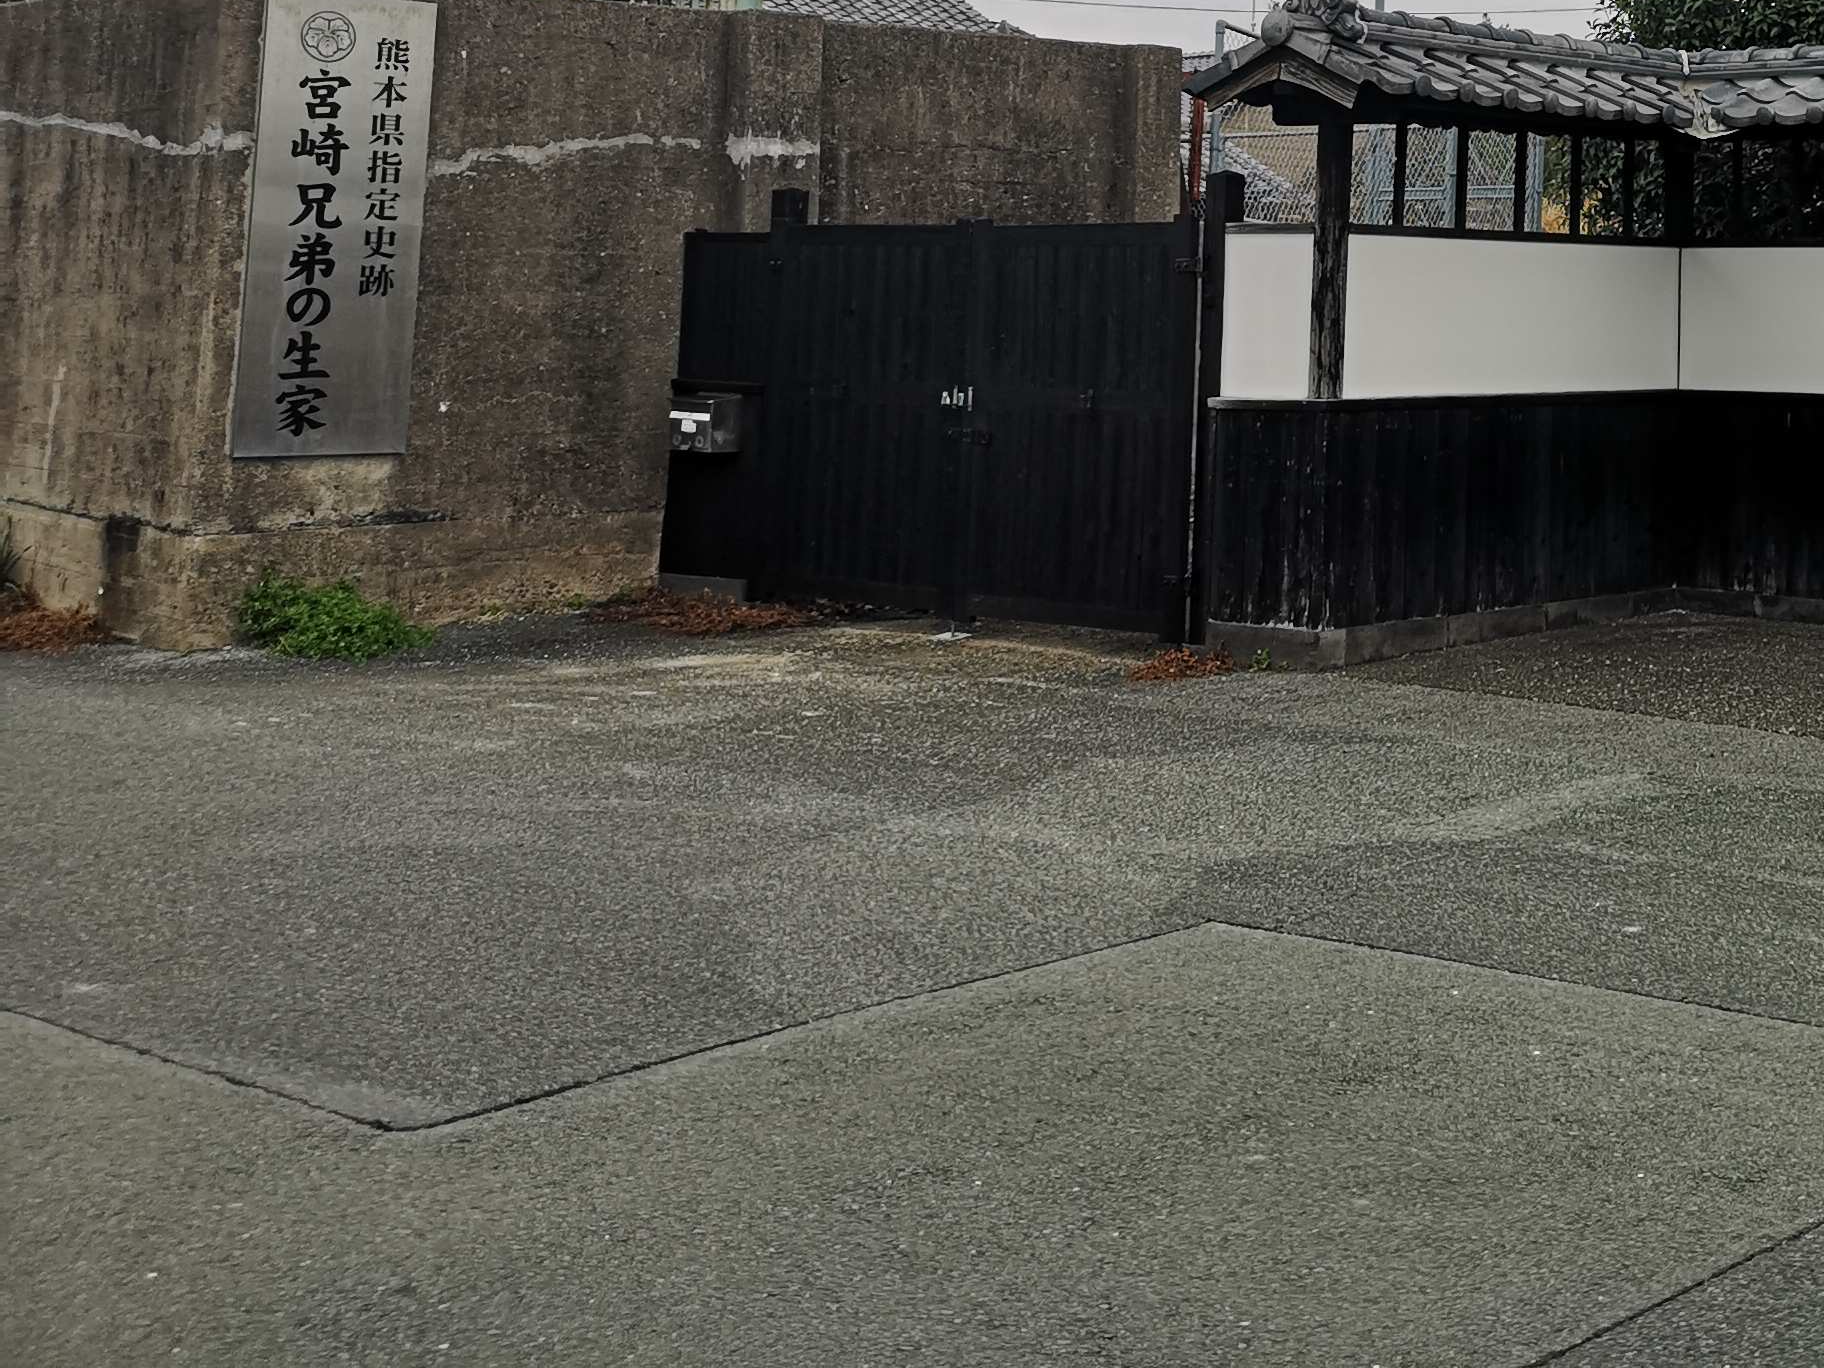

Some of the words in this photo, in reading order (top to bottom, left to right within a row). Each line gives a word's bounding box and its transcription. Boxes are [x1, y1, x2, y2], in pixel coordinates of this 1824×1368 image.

[275, 69, 351, 438] 宮崎兄弟の生家
[357, 37, 411, 297] 熊本県指定史跡
